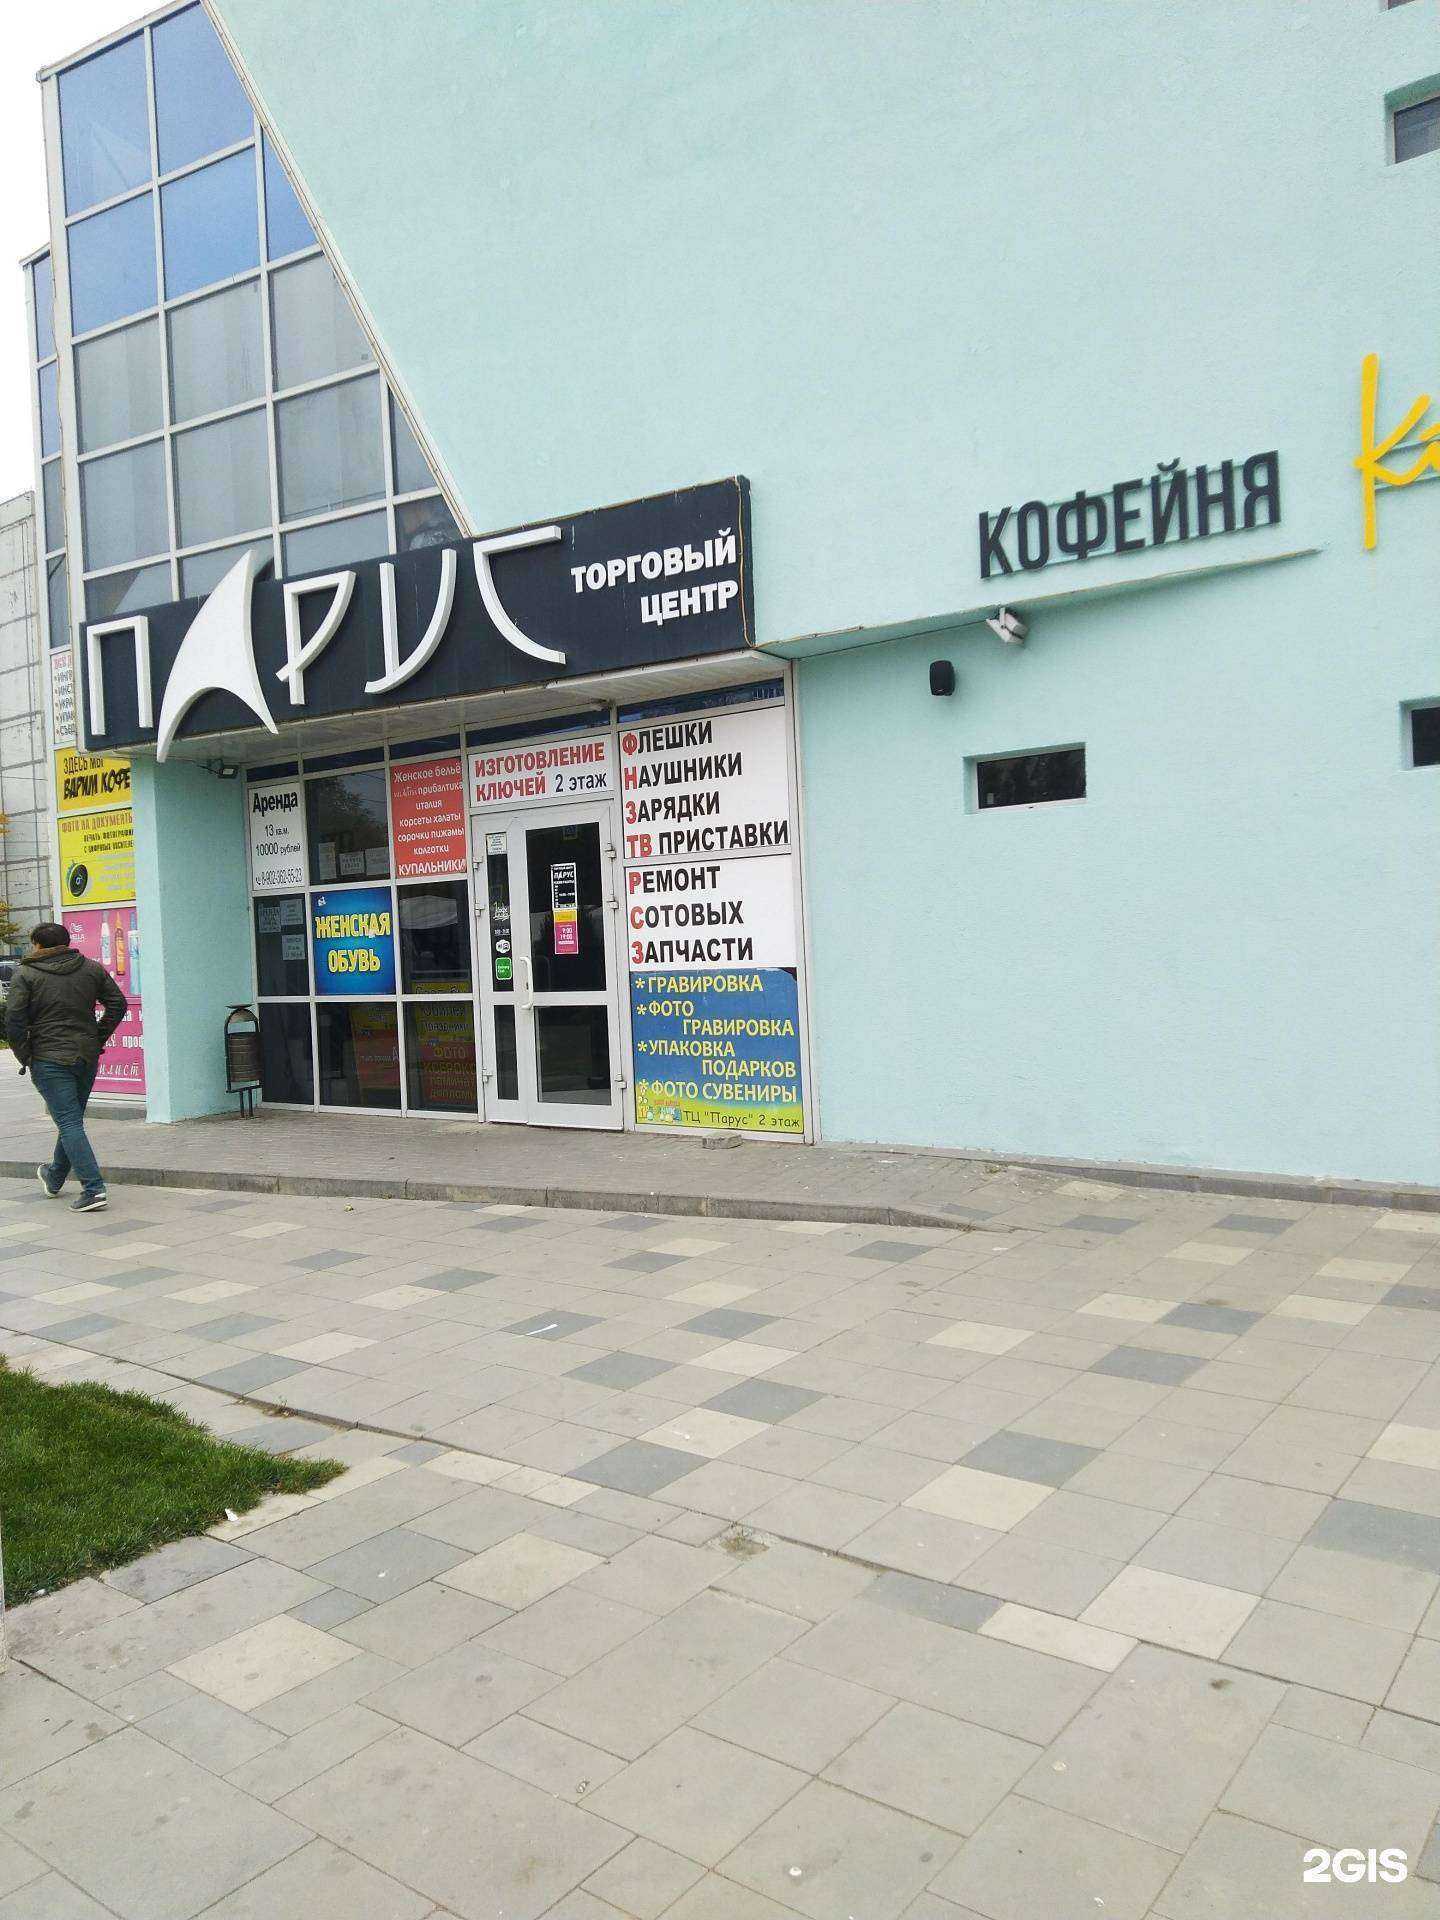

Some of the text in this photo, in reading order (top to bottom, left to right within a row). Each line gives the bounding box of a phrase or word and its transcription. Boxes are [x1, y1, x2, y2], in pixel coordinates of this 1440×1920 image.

[979, 450, 1281, 580] КОФЕЙНЯ
[571, 528, 737, 594] ТОРГОВЫЙ
[640, 580, 739, 625] ЦЕНТР
[86, 525, 566, 763] ПАРУС
[622, 720, 713, 756] ФЛЕШКИ
[475, 742, 605, 778] ИЗГОТОВЛЕНИЕ
[623, 752, 742, 791] НАУШНИКИ
[64, 768, 131, 800] ВАРИМ КОФЕ
[394, 770, 433, 783] Женское
[476, 771, 607, 802] КЛЮЧЕЙ 2 этаж
[253, 791, 299, 817] Аренда
[415, 800, 443, 810] италия
[625, 791, 720, 825] ЗАРЯДКИ
[265, 825, 274, 837] 13
[400, 813, 461, 827] корсеты халаты
[397, 827, 465, 843] сорочки пижамы
[626, 819, 789, 858] ТВ ПРИСТАВКИ
[256, 843, 278, 857] 10000
[414, 844, 449, 855] колготки
[399, 859, 467, 875] КУПАЛЬНИКИ
[628, 865, 721, 895] РЕМОНТ
[315, 912, 391, 938] ЖЕНСКАЯ
[630, 900, 744, 929] СОТОВЫХ
[328, 948, 381, 974] ОБУВЬ
[631, 937, 753, 964] ЗАПЧАСТИ
[683, 1019, 795, 1036] ГРАВИРОВКА
[702, 1059, 797, 1081] ПОДАРКОВ
[702, 1082, 797, 1103] СУВЕНИРЫ
[683, 1110, 700, 1124] ТЦ
[705, 1111, 753, 1127] "Парус"
[758, 1114, 766, 1125] 2
[771, 1115, 800, 1128] этаж
